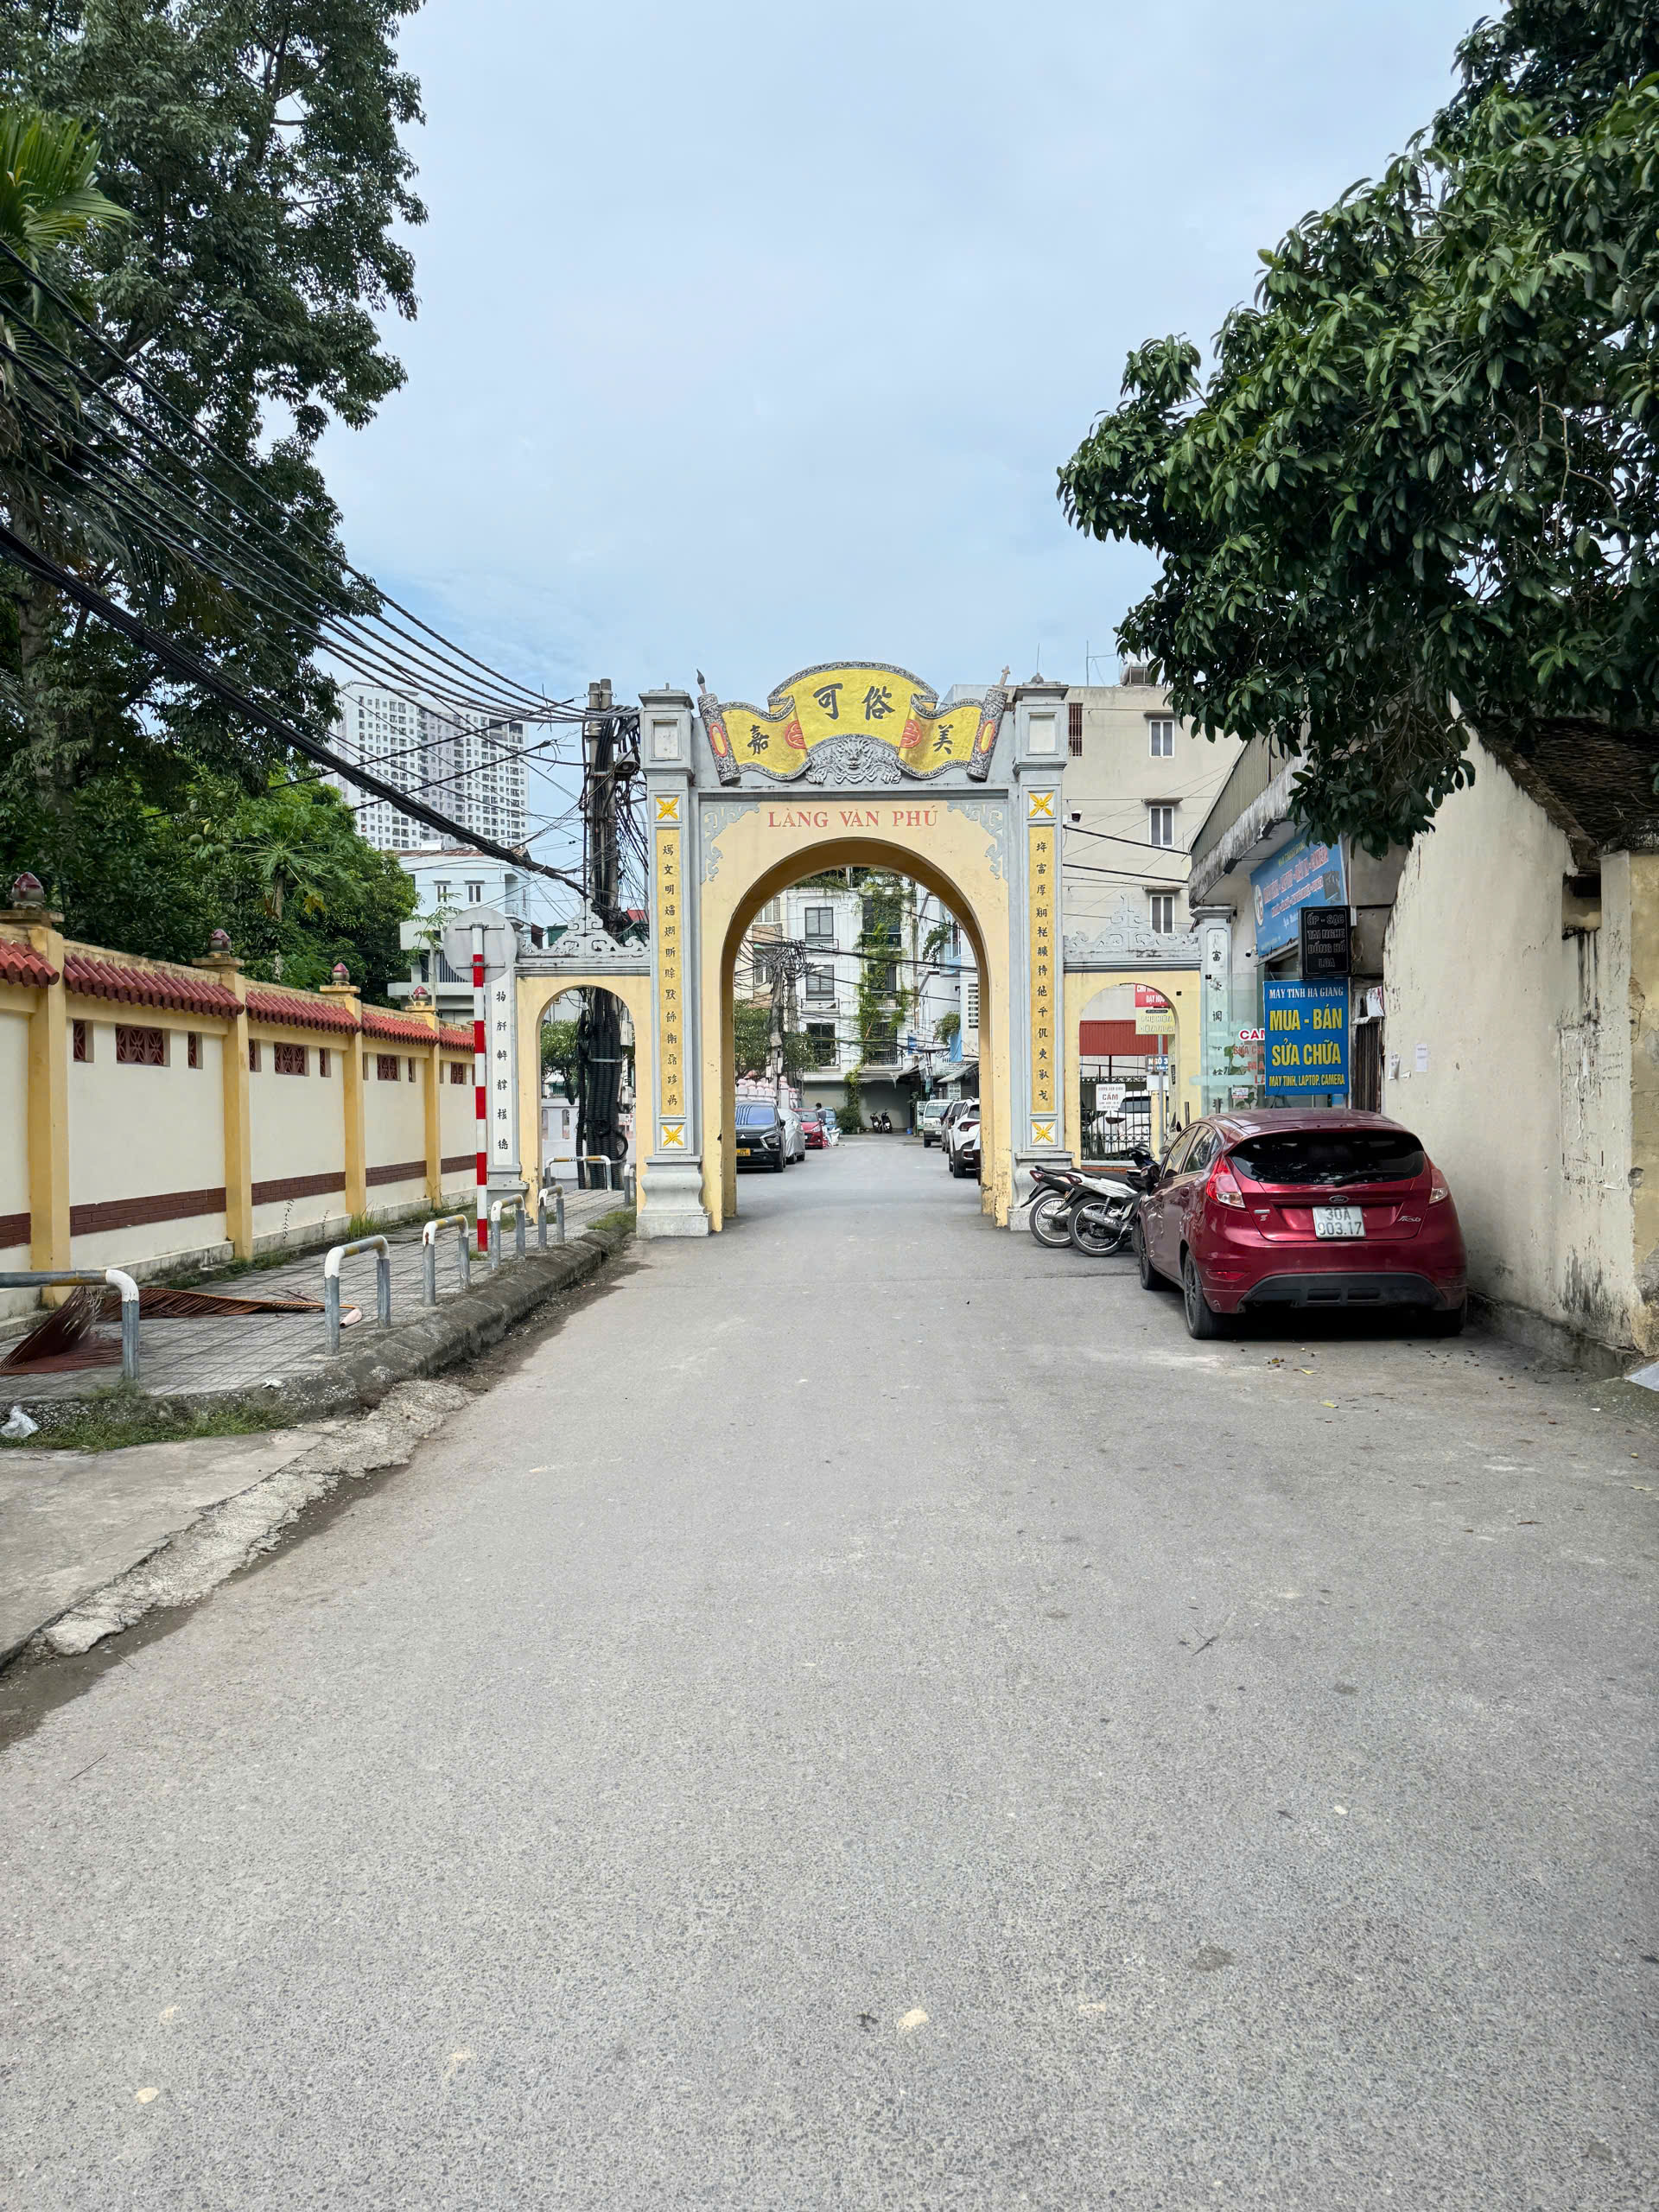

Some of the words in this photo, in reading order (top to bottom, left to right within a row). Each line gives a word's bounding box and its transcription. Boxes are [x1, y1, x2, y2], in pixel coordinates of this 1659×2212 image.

[768, 807, 829, 828] LÀNG
[839, 809, 880, 828] VĂN
[893, 804, 938, 827] PHÚ
[1307, 929, 1321, 939] TAI
[1322, 928, 1345, 939] NGHE
[1269, 987, 1286, 999] MÁY
[1287, 986, 1306, 998] TÍNH
[1319, 987, 1344, 997] GIANG
[1269, 1009, 1301, 1031] MUA
[1313, 1003, 1342, 1030] BÁN
[1271, 1038, 1300, 1066] SỬA
[1303, 1039, 1342, 1065] CHỮA
[1321, 1073, 1344, 1085] CAMERA
[1325, 1207, 1351, 1221] 30A
[1318, 1222, 1362, 1236] 903.17
